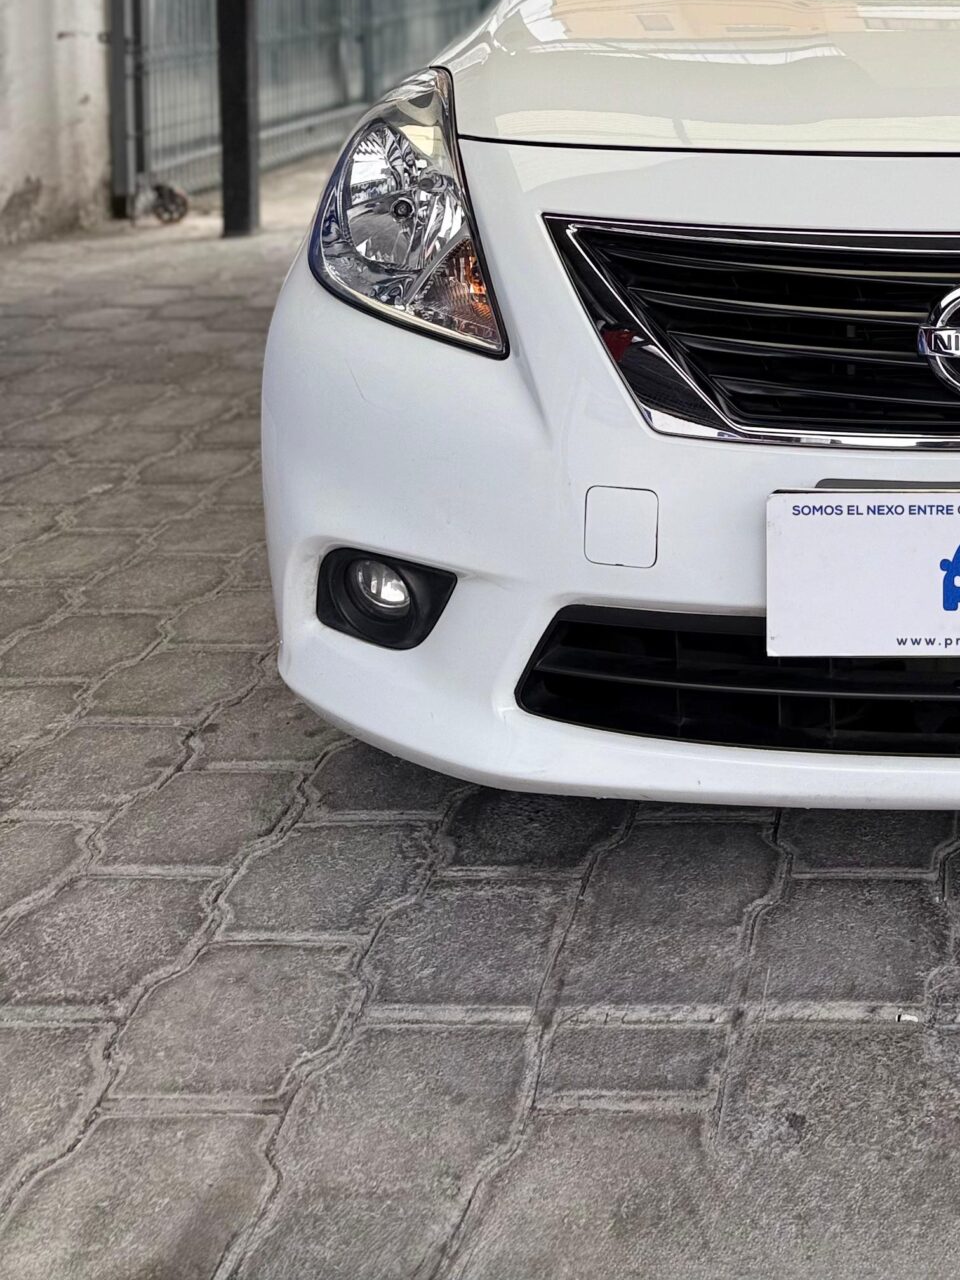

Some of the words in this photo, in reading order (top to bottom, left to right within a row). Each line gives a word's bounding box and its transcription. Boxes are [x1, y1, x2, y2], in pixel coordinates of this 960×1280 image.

[792, 504, 844, 517] SOMOS
[847, 504, 864, 517] EL
[866, 504, 905, 517] NEXO
[908, 504, 954, 517] ENTRE
